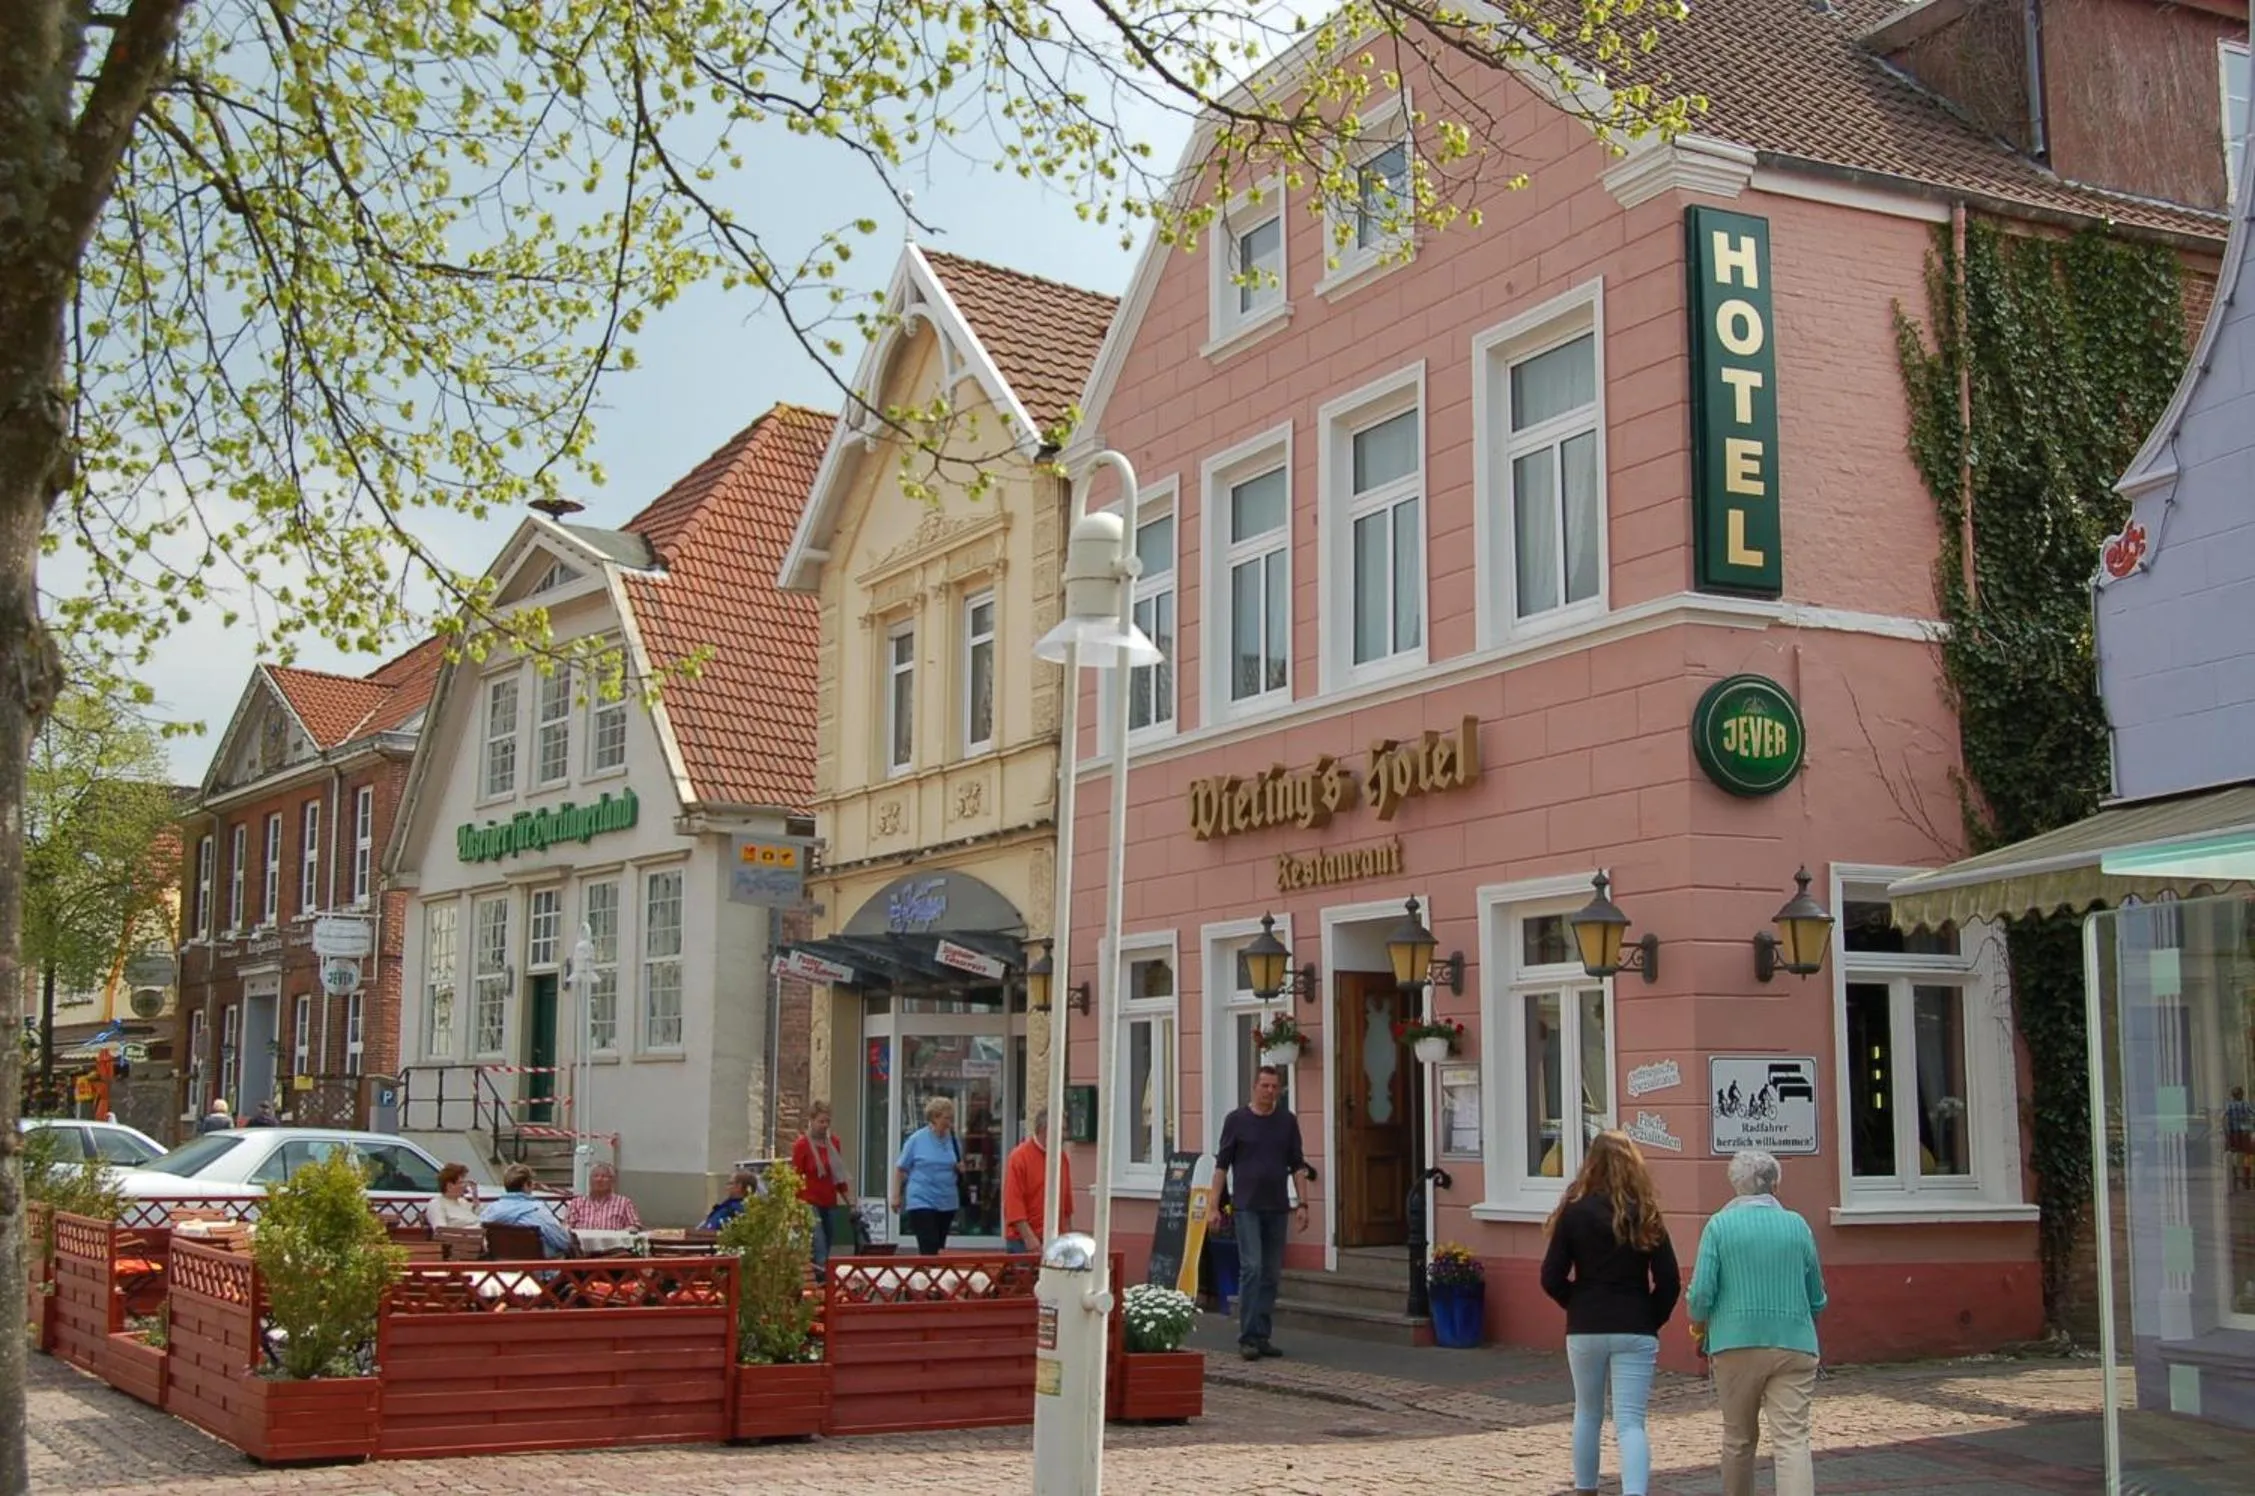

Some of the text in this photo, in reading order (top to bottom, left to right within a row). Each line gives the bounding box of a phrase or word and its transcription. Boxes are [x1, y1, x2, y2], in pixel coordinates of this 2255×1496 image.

[1712, 231, 1765, 567] HOTEL
[1723, 715, 1787, 758] JEVER
[1189, 714, 1479, 841] Wieting's Hotel
[1276, 833, 1404, 893] Restaurant
[383, 1091, 393, 1105] P
[1716, 1135, 1814, 1148] herzlich willkommen!
[1742, 1123, 1788, 1133] Radfahrer
